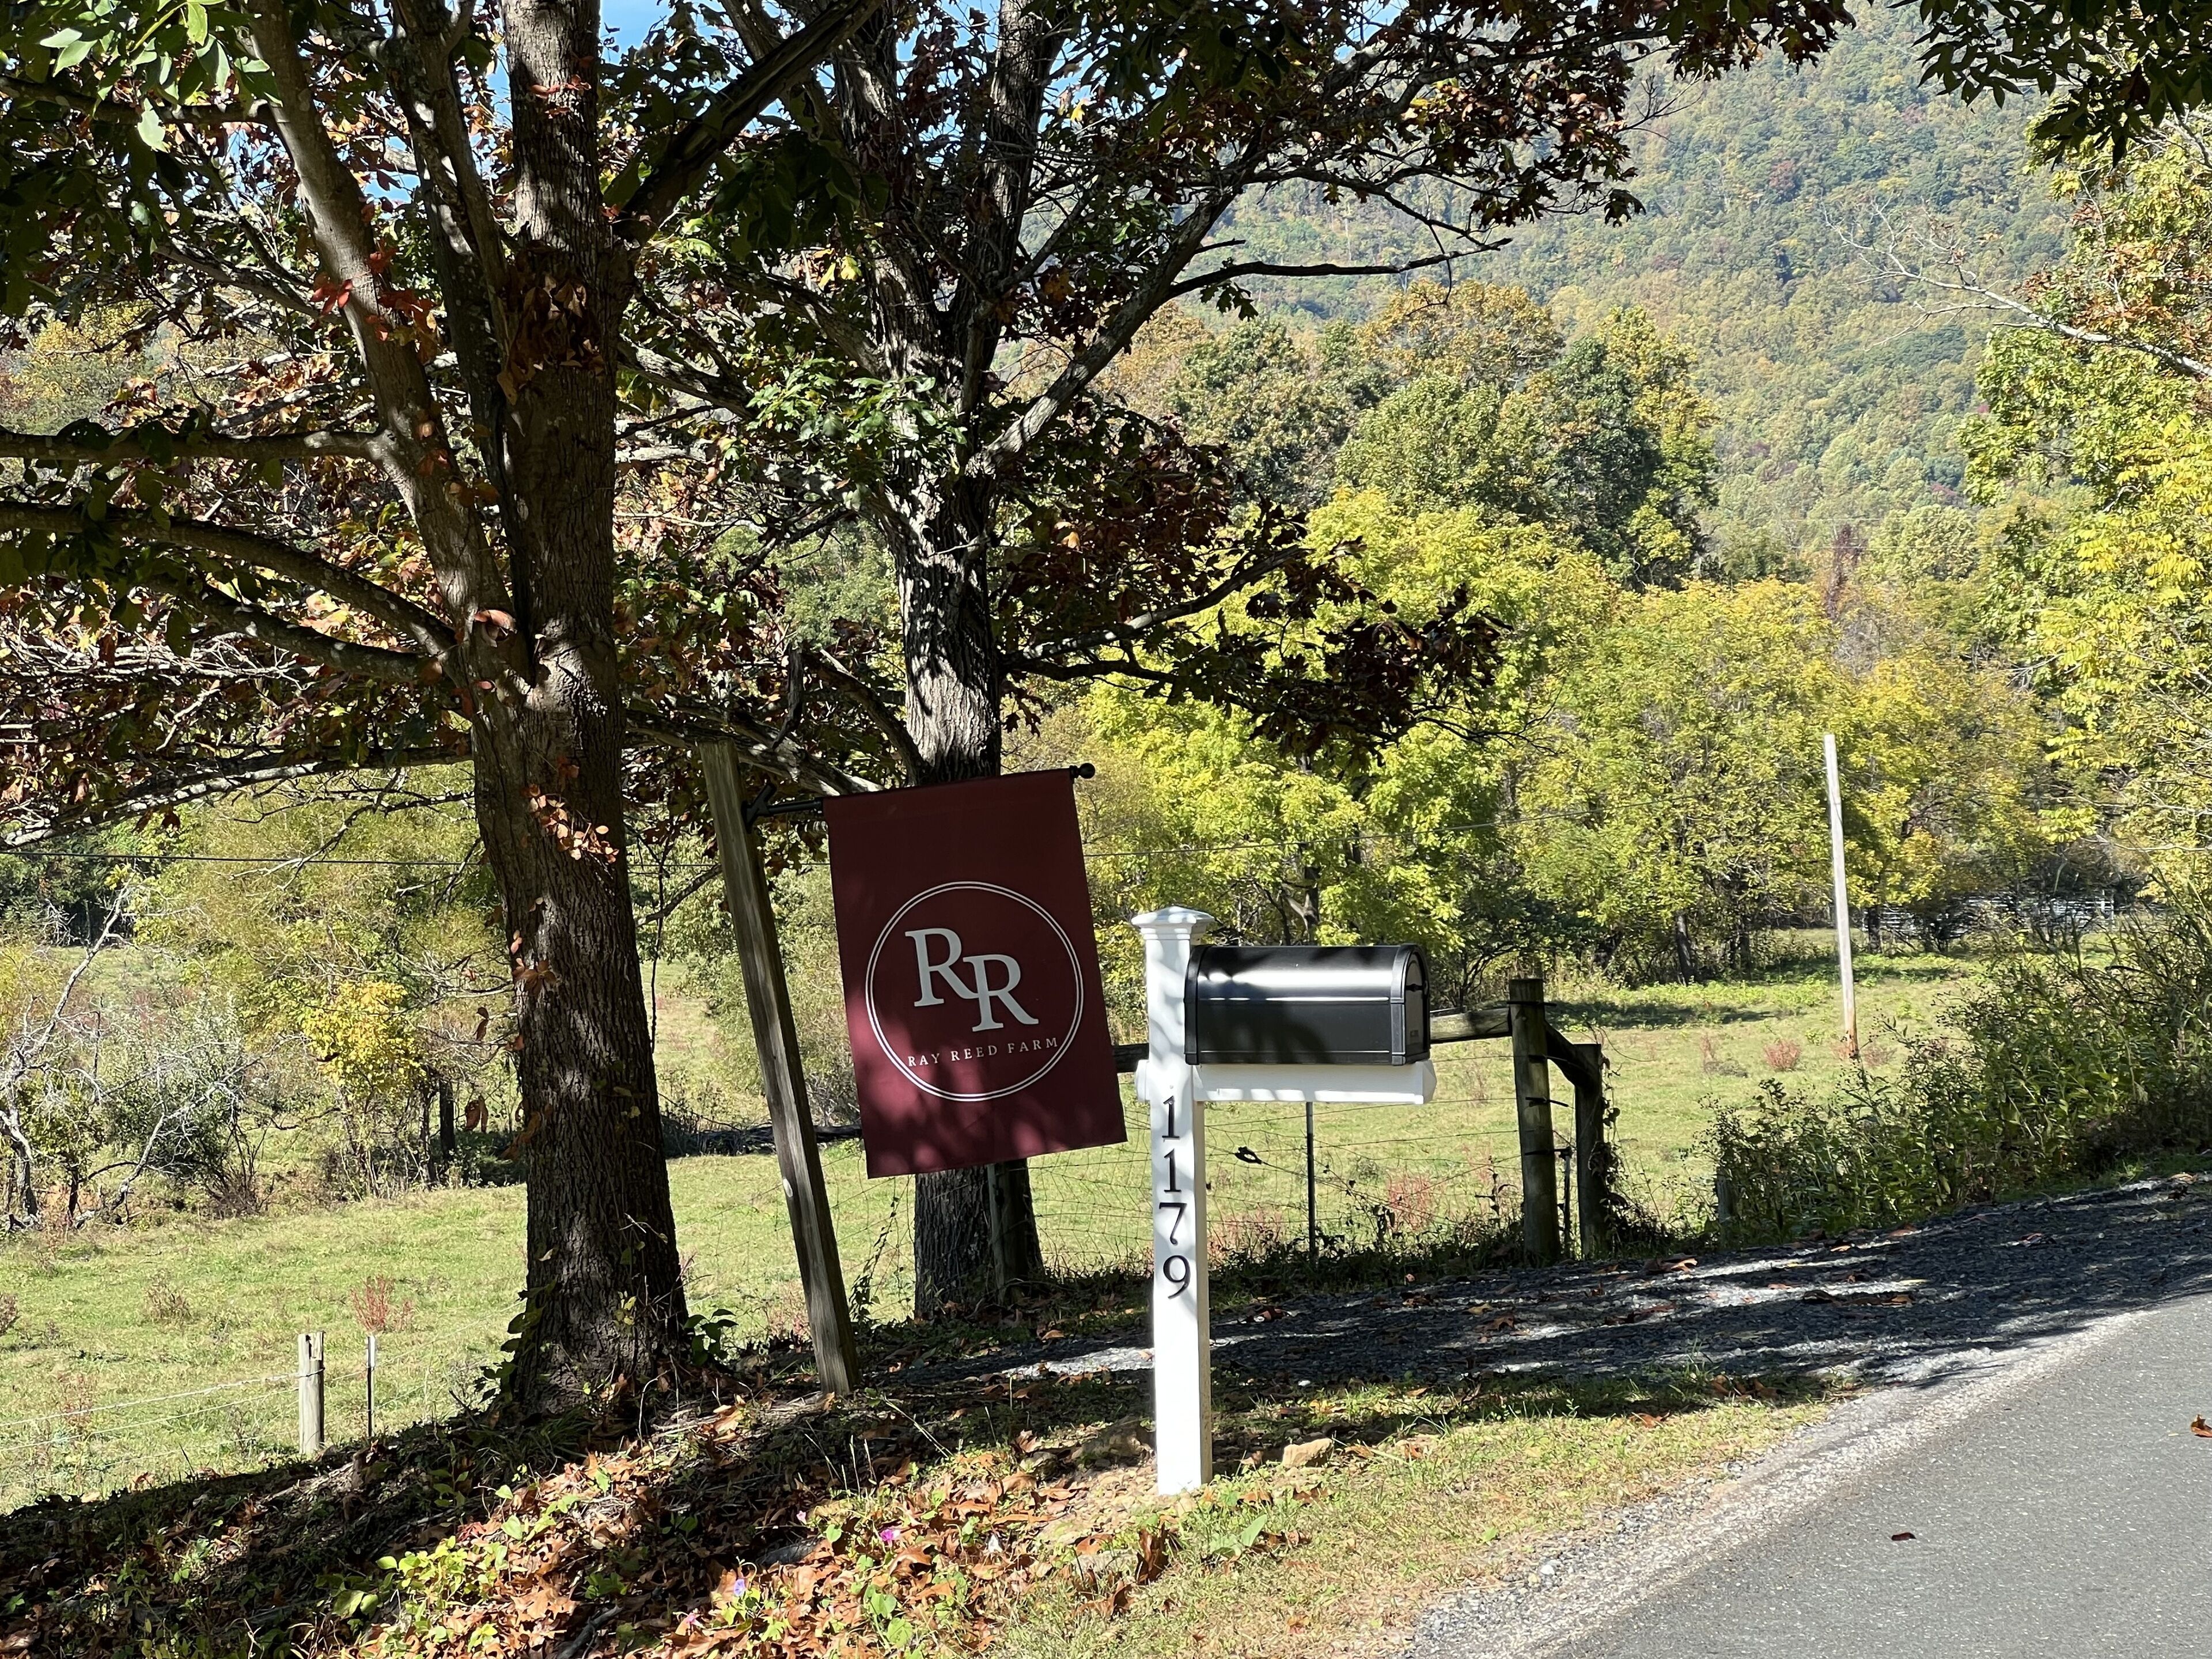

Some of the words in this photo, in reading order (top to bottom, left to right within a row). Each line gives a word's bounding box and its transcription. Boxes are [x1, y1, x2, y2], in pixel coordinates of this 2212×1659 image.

[905, 927, 1039, 1032] RR
[908, 1052, 940, 1066] RAY
[950, 1045, 998, 1062] REED
[1007, 1037, 1058, 1054] FARM
[1159, 1095, 1191, 1300] 1179
